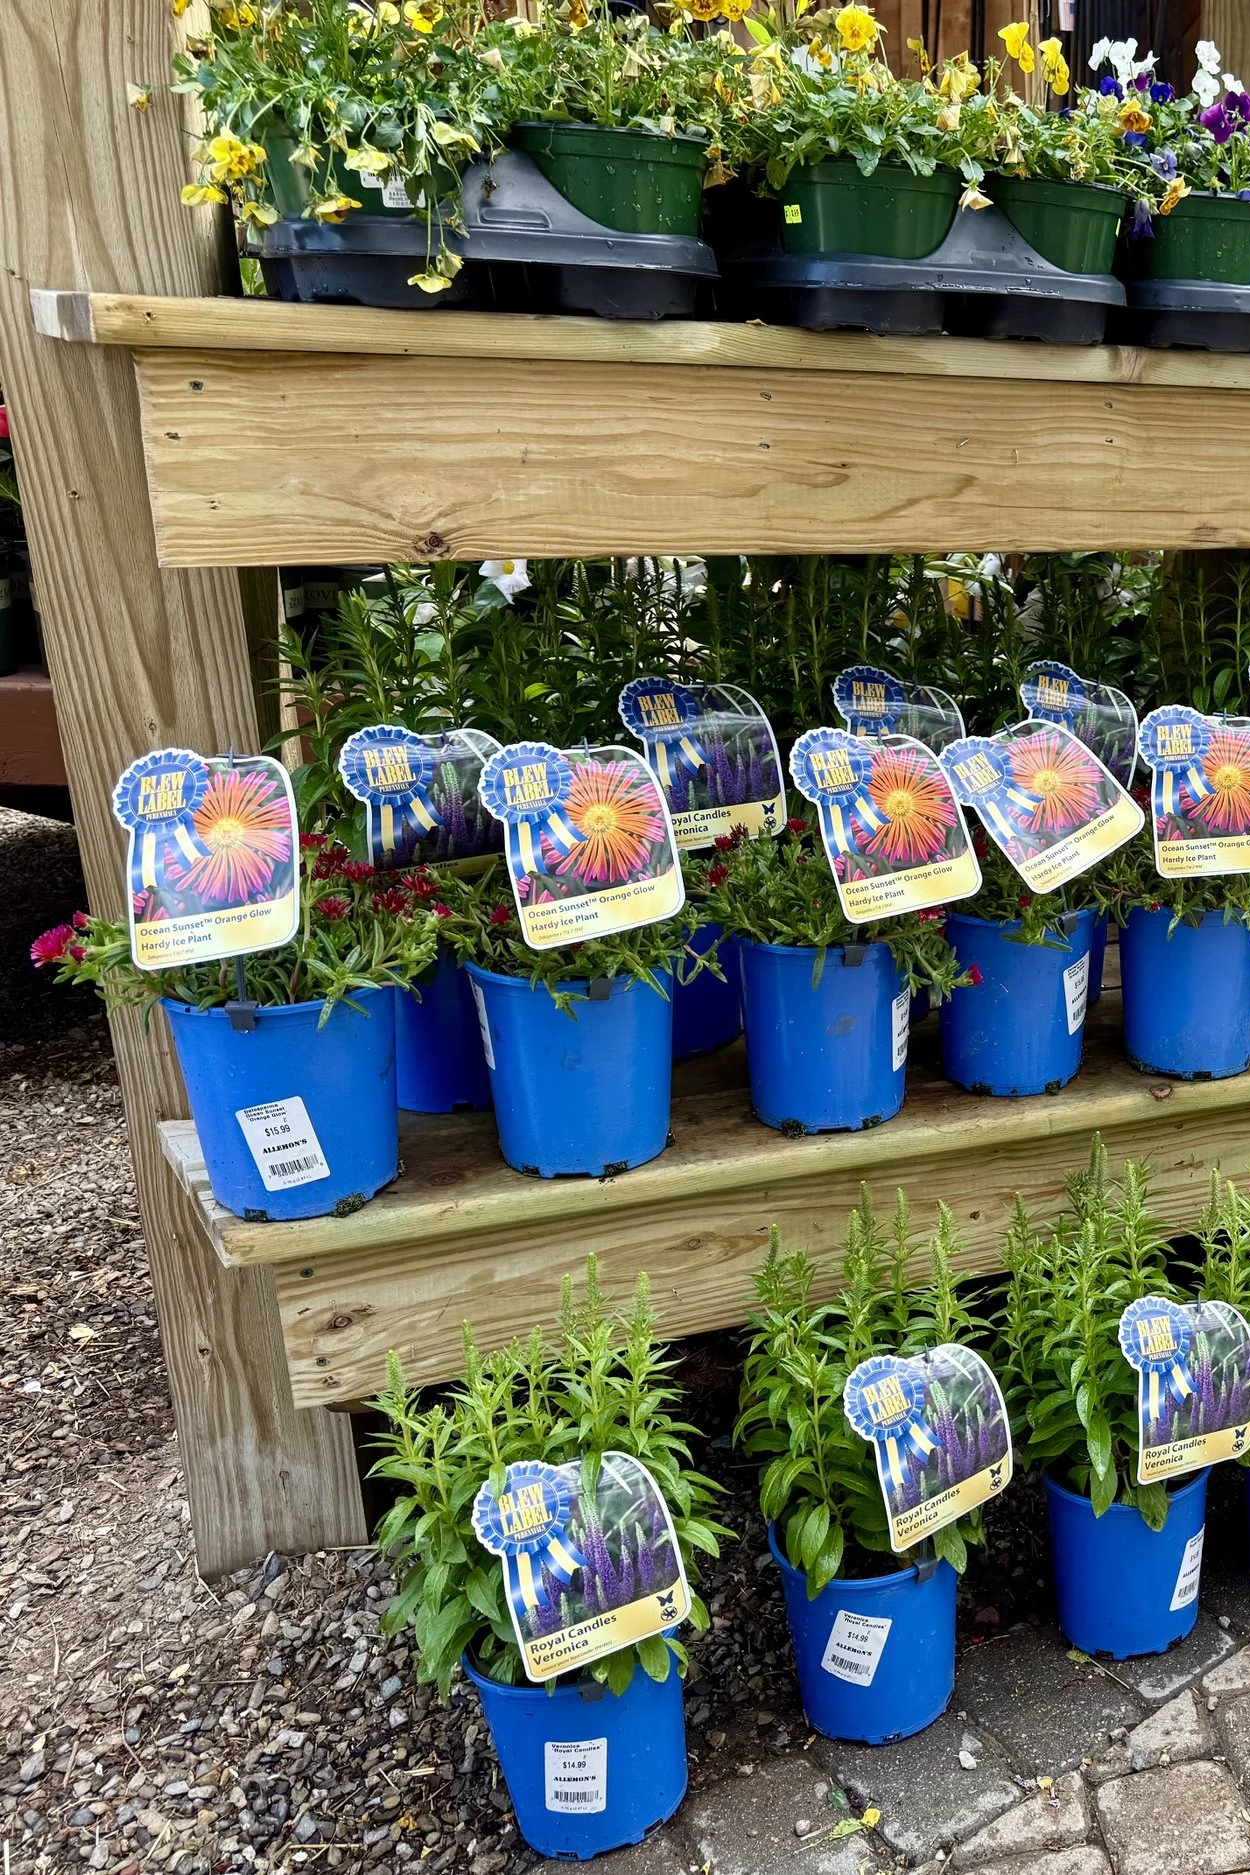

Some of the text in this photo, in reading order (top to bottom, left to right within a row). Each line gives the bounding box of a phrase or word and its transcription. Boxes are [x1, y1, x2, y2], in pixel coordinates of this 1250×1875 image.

[852, 681, 885, 697] BLEW
[638, 693, 676, 711] BLEW
[853, 696, 888, 713] LABEL
[641, 709, 683, 727] LABEL
[1157, 724, 1192, 740] BLEW
[363, 746, 408, 769] BLEW
[1157, 738, 1195, 756] LABEL
[809, 750, 849, 770] BLEW
[952, 752, 990, 779] BLEW
[140, 771, 187, 791] BLEW
[366, 764, 416, 787] LABEL
[503, 763, 546, 787] BLEW
[814, 765, 858, 788] LABEL
[962, 767, 1002, 794] LABEL
[138, 791, 186, 815] LABEL
[504, 782, 554, 805] LABEL
[672, 810, 731, 825] oyal Candles
[674, 826, 709, 837] eronica
[1025, 858, 1046, 872] Ocean
[1074, 826, 1099, 844] Orange
[1098, 814, 1115, 828] Glow
[1162, 844, 1184, 852] Ocean
[1218, 840, 1245, 848] Orange
[1031, 868, 1053, 883] Hardy
[1053, 861, 1063, 871] Ice
[1062, 851, 1081, 865] Plant
[846, 884, 869, 895] Ocean
[904, 870, 932, 882] Orange
[933, 865, 952, 875] Glow
[528, 908, 557, 919] Ocean
[599, 891, 631, 904] Orange
[633, 885, 655, 896] Glow
[849, 889, 905, 908] Hardy Ice Plant
[140, 926, 170, 937] Ocean
[215, 913, 248, 925] Orange
[249, 907, 271, 918] Glow
[531, 912, 599, 933] Hardy Ice Plant
[141, 933, 212, 951] Hardy Ice Plant
[265, 1125, 290, 1137] $15.99
[263, 1139, 307, 1154] ALLEMON'S
[1136, 1316, 1170, 1337] BLEW
[1140, 1333, 1177, 1356] LABEL
[861, 1373, 902, 1405] BLEW
[868, 1392, 911, 1424] LABEL
[1145, 1437, 1206, 1459] Royal Candles
[1144, 1455, 1183, 1470] Veronica
[499, 1482, 544, 1512] BLEW
[896, 1507, 923, 1528] Royal
[924, 1487, 960, 1511] Candles
[500, 1505, 552, 1537] LABEL
[897, 1511, 938, 1538] Veronica
[530, 1632, 566, 1655] Royal
[568, 1614, 617, 1639] Candles
[848, 1632, 868, 1642] $14.99
[533, 1638, 589, 1666] Veronica
[836, 1642, 872, 1656] ALLEMON'S
[563, 1761, 586, 1769] $14.99
